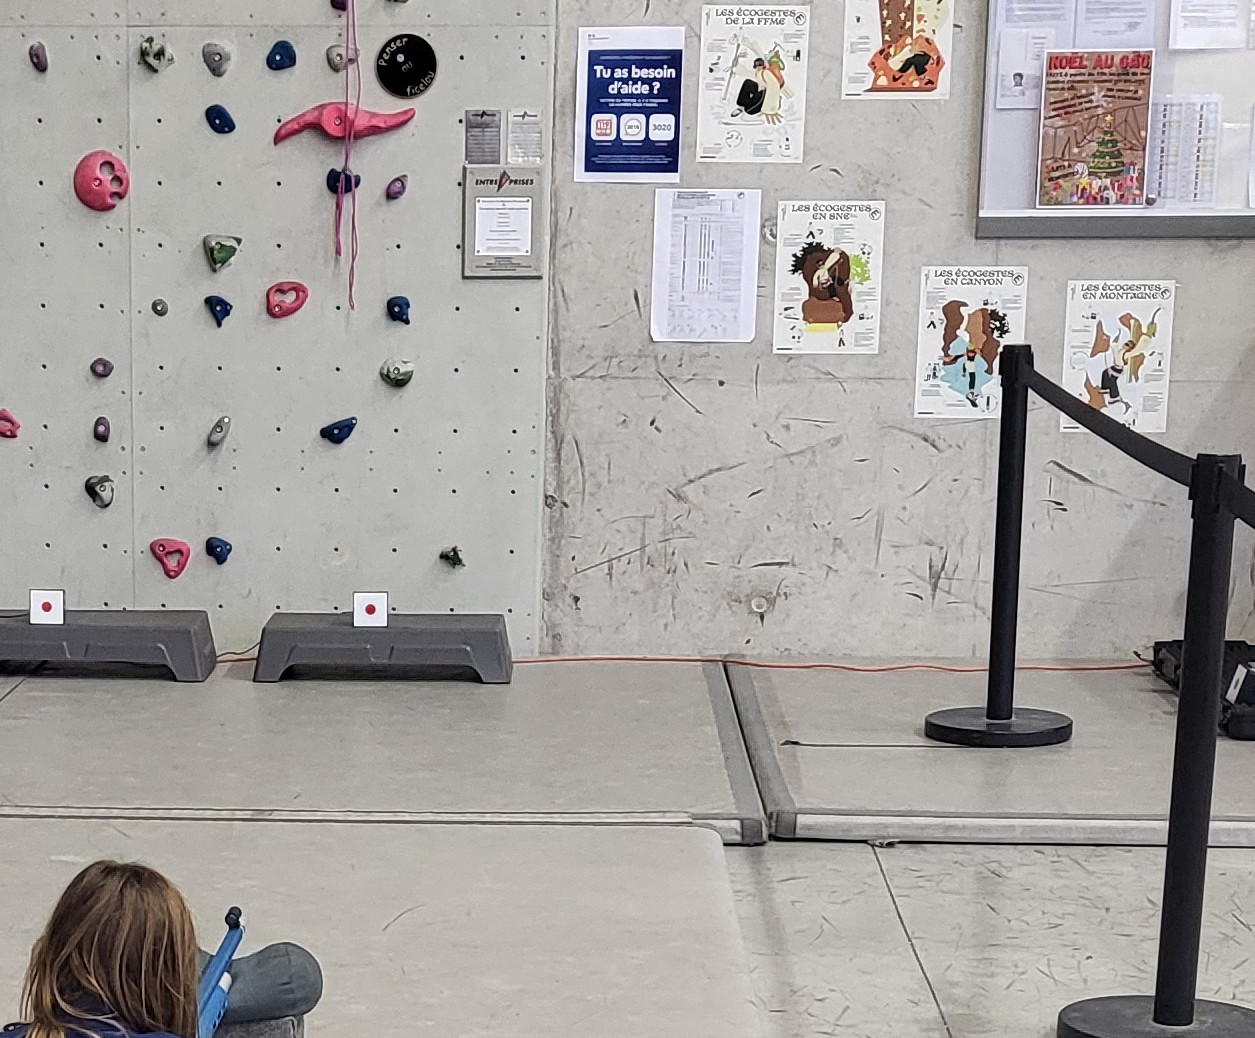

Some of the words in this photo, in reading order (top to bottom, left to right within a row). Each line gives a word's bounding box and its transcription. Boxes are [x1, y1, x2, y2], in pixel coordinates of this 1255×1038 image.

[715, 9, 734, 17] LES
[736, 7, 796, 17] ÉCOGESTES
[1092, 54, 1115, 70] AU
[593, 65, 611, 78] Tu
[614, 68, 629, 78] as
[631, 64, 676, 78] besoin
[608, 80, 650, 94] d'aide
[652, 81, 661, 94] ?
[652, 123, 672, 131] 3020
[791, 204, 810, 212] LES
[812, 202, 872, 213] ÉCOGESTES
[955, 268, 1015, 278] ÉCOGESTES
[960, 278, 1003, 286] CANYON
[1081, 284, 1100, 292] LES
[1101, 282, 1161, 292] ÉCOGESTES
[1082, 292, 1097, 300] EN
[1099, 292, 1158, 300] MONTAGNE
